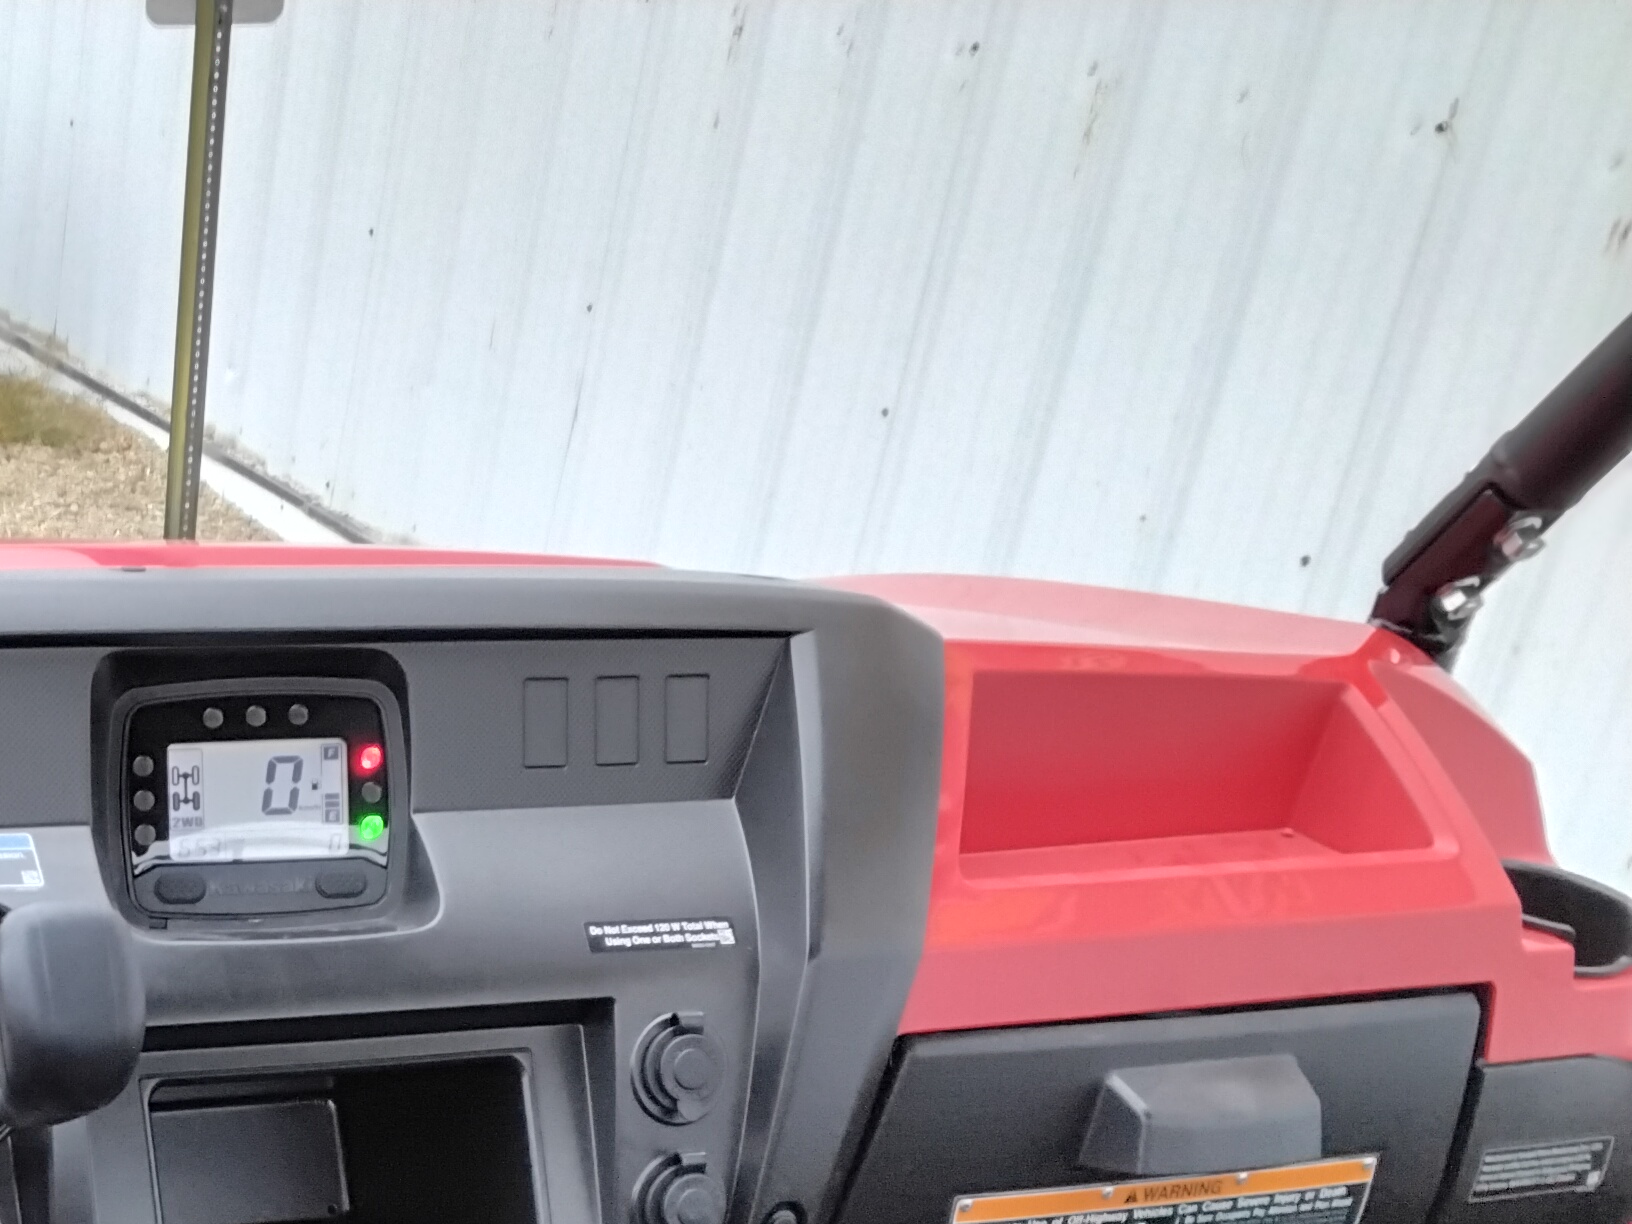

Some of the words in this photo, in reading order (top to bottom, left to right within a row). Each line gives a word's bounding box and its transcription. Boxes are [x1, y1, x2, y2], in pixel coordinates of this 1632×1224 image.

[261, 755, 303, 815] 0
[172, 817, 203, 828] 2WD
[589, 926, 603, 936] Do
[603, 925, 620, 935] Not
[621, 923, 654, 934] Exceed
[654, 923, 670, 932] 120
[671, 922, 680, 931] W
[681, 921, 703, 931] Total
[703, 920, 729, 930] When
[604, 936, 631, 947] Using
[632, 935, 651, 945] One
[652, 936, 662, 944] or
[663, 934, 684, 943] Both
[1143, 1180, 1222, 1201] WARNING
[1133, 1206, 1173, 1220] Vehicles
